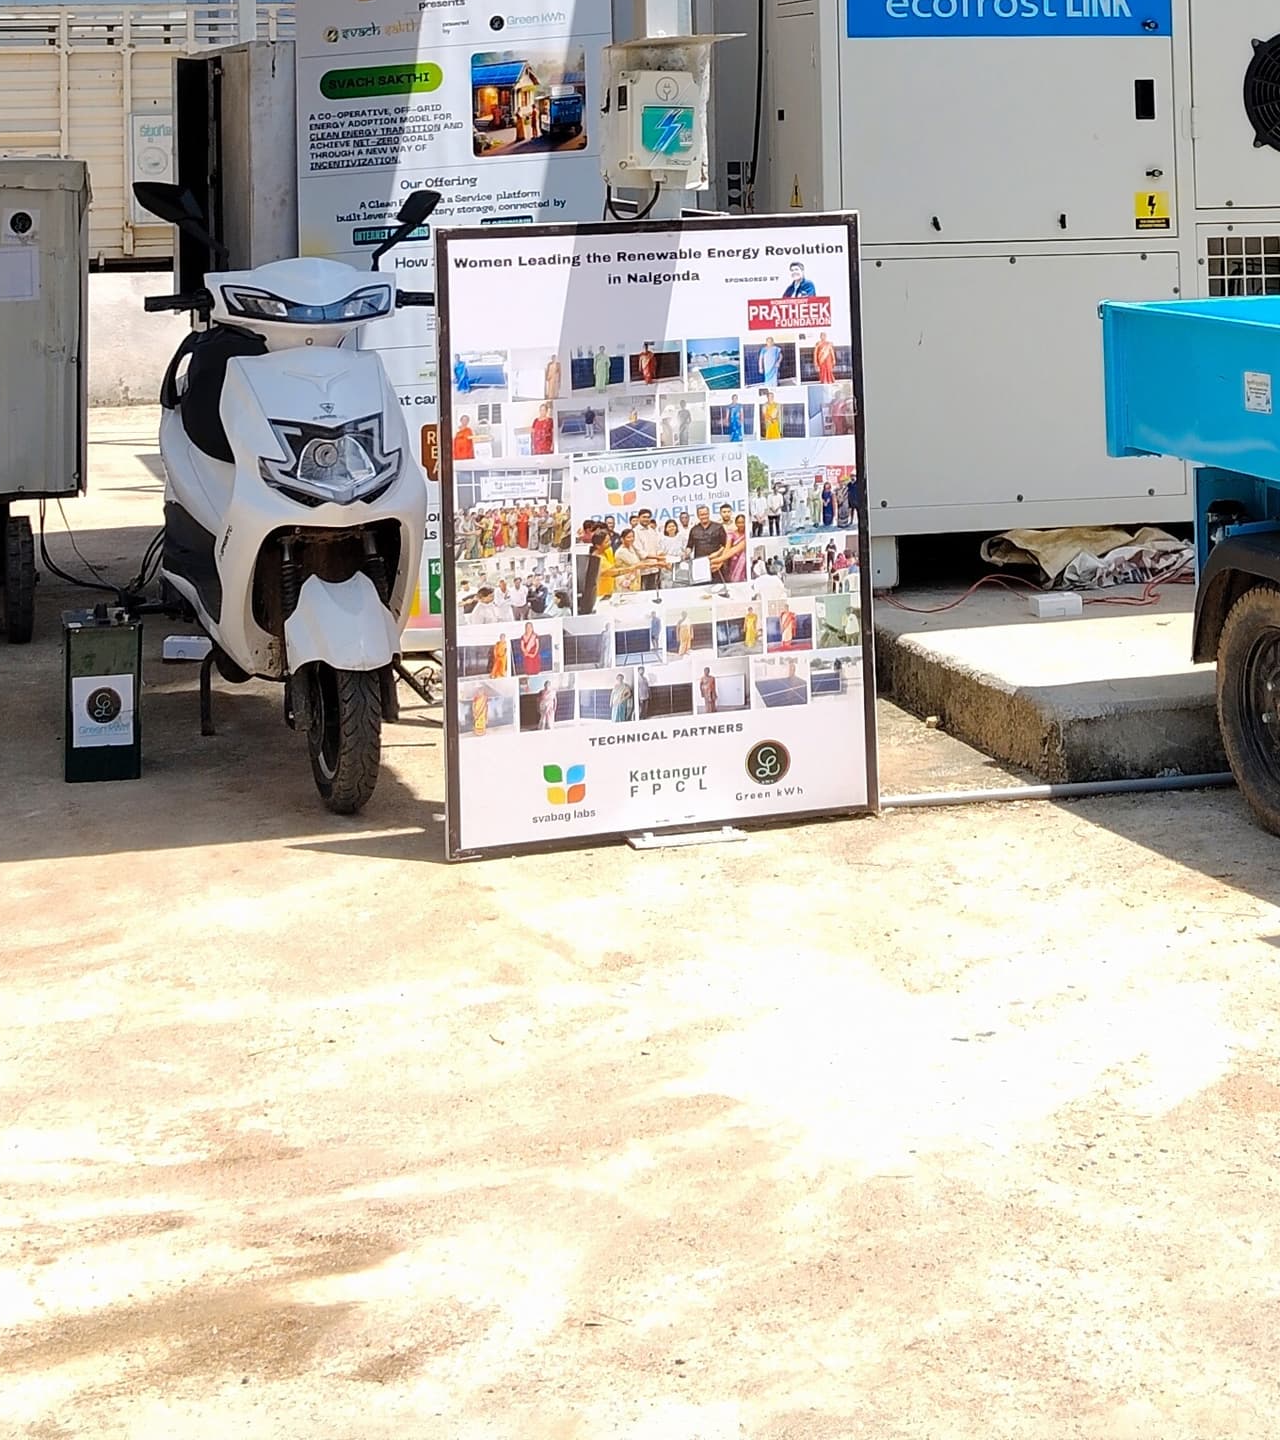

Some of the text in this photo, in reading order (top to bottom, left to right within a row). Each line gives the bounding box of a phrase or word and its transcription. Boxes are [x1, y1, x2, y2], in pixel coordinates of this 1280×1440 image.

[506, 13, 540, 26] Green
[328, 72, 430, 90] SVACH SAKTHI
[309, 121, 345, 131] ENERGY
[347, 118, 397, 128] ADOPTION
[399, 115, 431, 123] MODEL
[309, 122, 463, 141] CLEAN ENERGY TRANSITION AND
[309, 134, 434, 150] ACHIEVE NET-ZERO GOALS
[310, 150, 355, 160] THROUGH
[357, 148, 364, 156] A
[365, 147, 388, 155] NEW
[390, 145, 413, 154] WAY
[400, 176, 478, 190] Our Offering
[359, 201, 367, 210] A
[368, 199, 397, 209] Clean
[455, 193, 492, 202] Service
[496, 190, 540, 202] platform
[498, 200, 550, 212] connected
[554, 198, 566, 209] by
[395, 257, 428, 269] How
[454, 243, 844, 268] Women Leading the Renewable Energy Revolution
[607, 271, 700, 285] in Nalgonda
[749, 303, 831, 321] PRATHEEK
[775, 317, 831, 328] FOUNDATION
[583, 460, 659, 475] KOMATIREDDY
[662, 455, 716, 467] PRATHEEK
[641, 471, 717, 491] svabag
[708, 491, 730, 500] India
[589, 723, 744, 747] TECHNICAL PARTNERS
[629, 764, 708, 783] Kattangur
[735, 787, 804, 801] Green kWh
[532, 808, 596, 824] svabag labs
